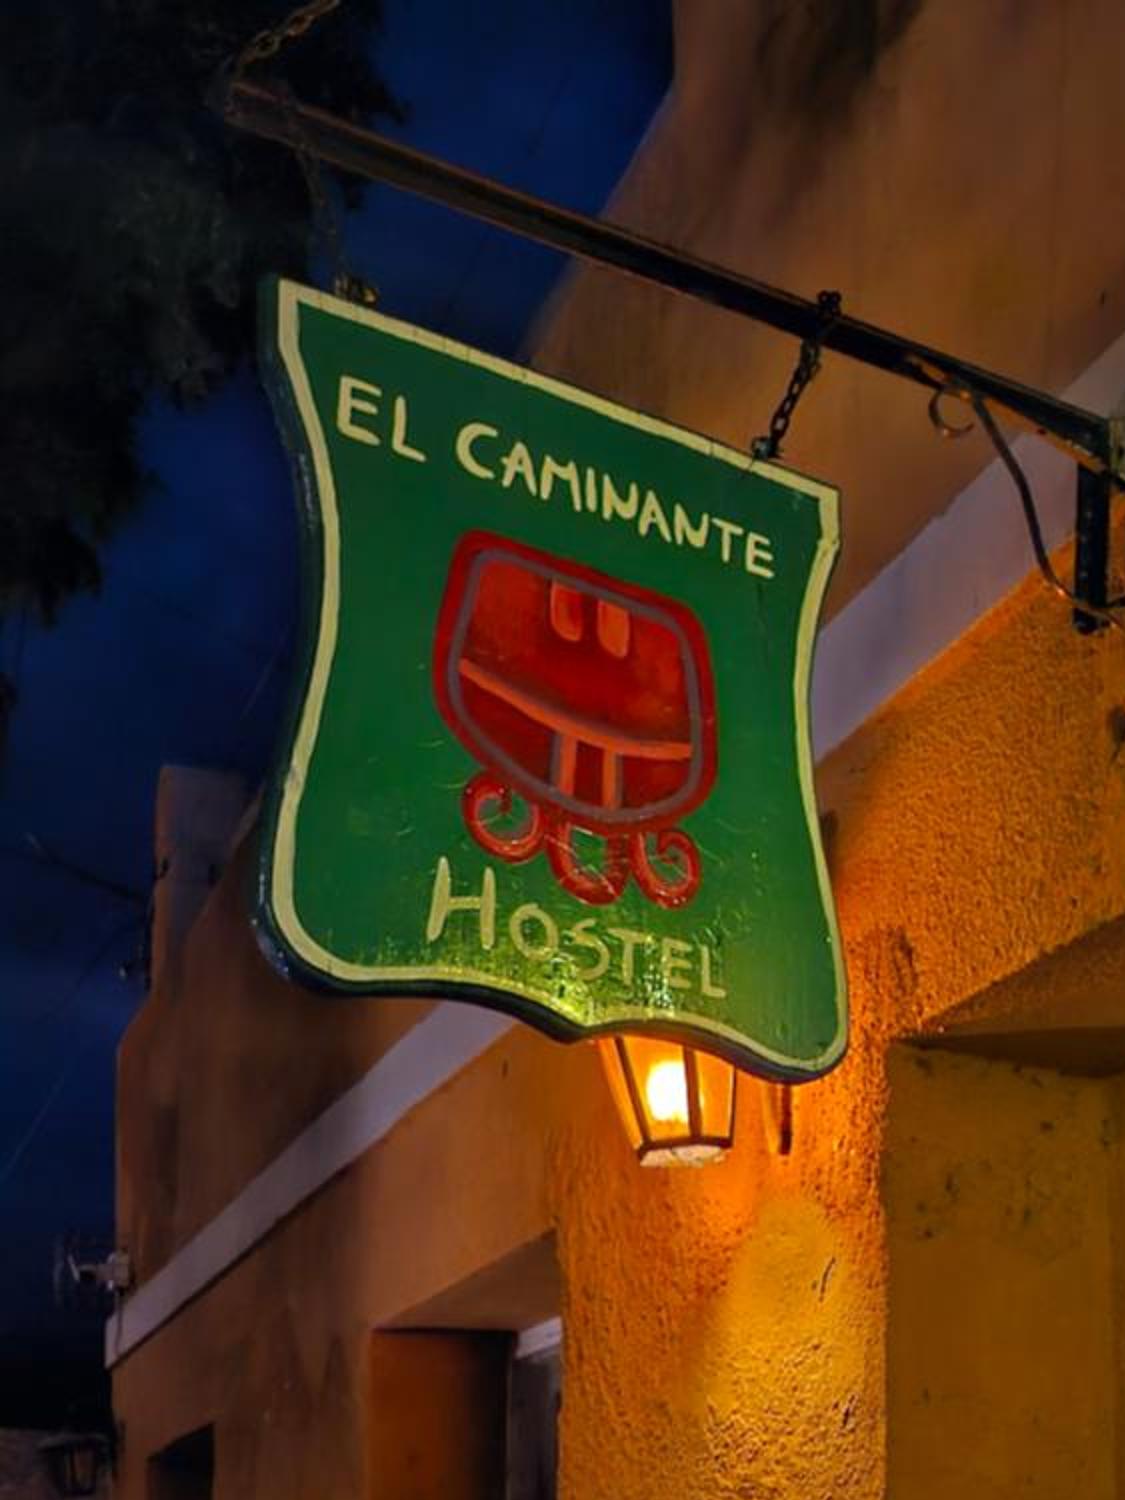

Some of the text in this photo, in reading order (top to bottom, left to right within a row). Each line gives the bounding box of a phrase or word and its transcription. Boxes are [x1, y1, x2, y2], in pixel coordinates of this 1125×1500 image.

[337, 374, 775, 579] EL CAMINANTE
[426, 855, 727, 999] HOSTEL
